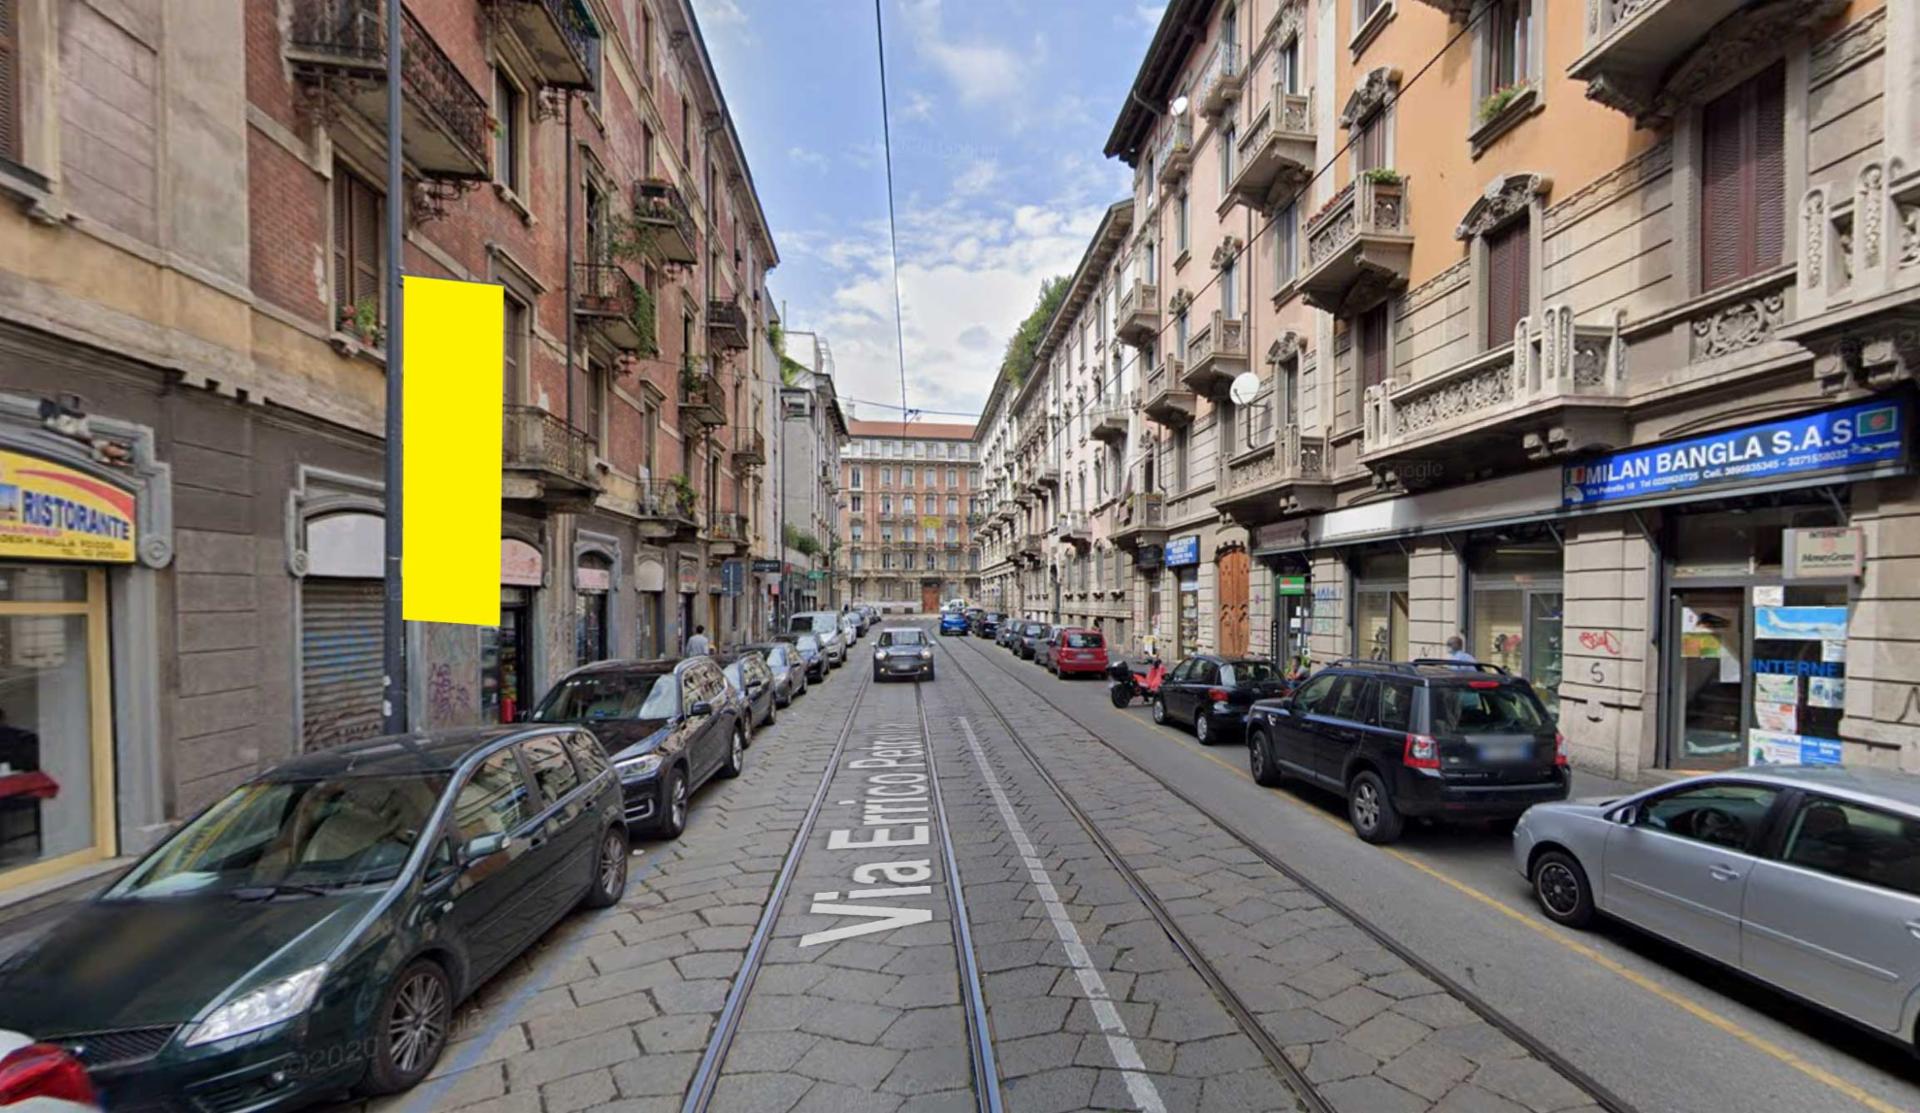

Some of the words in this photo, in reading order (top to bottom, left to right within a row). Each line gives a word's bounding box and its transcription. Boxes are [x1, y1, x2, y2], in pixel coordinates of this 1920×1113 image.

[1586, 456, 1650, 485] MILAN
[1657, 435, 1764, 473] BANGLA
[1772, 419, 1852, 455] S.A.S
[23, 490, 129, 540] RISTORANTE
[1802, 552, 1855, 564] MoneyGram
